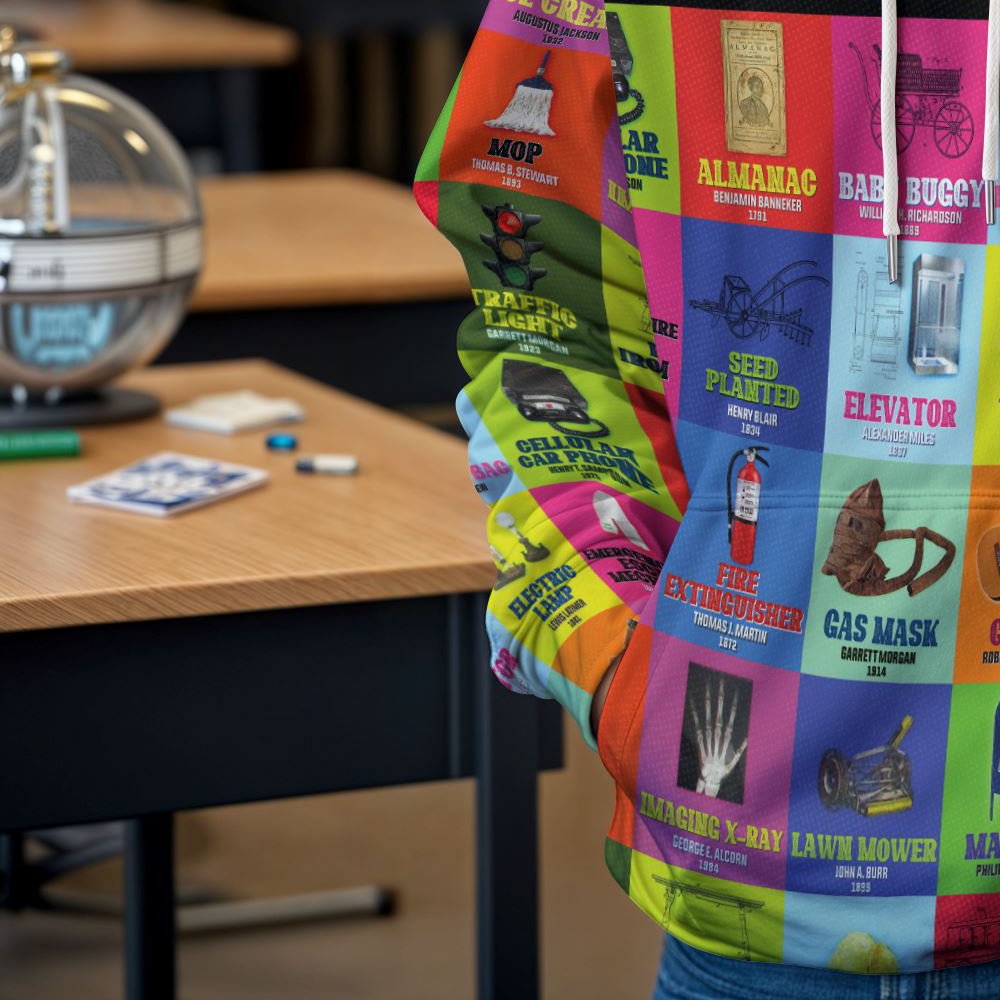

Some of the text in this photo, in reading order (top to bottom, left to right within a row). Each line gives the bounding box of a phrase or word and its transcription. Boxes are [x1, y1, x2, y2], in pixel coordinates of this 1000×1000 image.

[514, 10, 600, 41] AUGUSTUS JACKSON
[486, 138, 543, 165] MOP
[472, 158, 559, 187] THOMAS STEWART
[697, 157, 818, 197] ALMANAC
[713, 190, 802, 213] BENJAMIN BANNEKER
[838, 172, 986, 209] BAB BUGGY
[748, 210, 768, 222] 1791
[908, 210, 962, 225] RICHARDSON
[471, 289, 577, 329] TRAFFIC
[483, 308, 563, 339] LIGHT
[728, 351, 779, 379] SEED
[705, 367, 800, 411] PLANTED
[727, 403, 778, 427] HENRY BLAIR
[843, 390, 957, 428] ELEVATOR
[741, 422, 760, 437] 1834
[862, 427, 936, 446] ALEXANDER MILES
[515, 436, 640, 467] CELLULAR
[518, 450, 660, 495] CAR PHONE
[508, 565, 577, 620] ELECTRIC
[716, 562, 760, 597] FIRE
[532, 585, 574, 622] LAMP
[664, 573, 804, 634] EXTINGUISHER
[694, 611, 768, 645] THOMAS MARTIN
[823, 608, 940, 647] GAS MASK
[719, 636, 738, 651] 1872
[867, 665, 887, 677] 1914
[640, 791, 783, 853] IMAGING X-RAY
[672, 834, 748, 867] GEORGE ALCORN
[790, 832, 937, 864] LAWN MOWER
[698, 860, 719, 874] 1984
[835, 865, 888, 880] JOHN BURR
[851, 882, 871, 893] 1899
